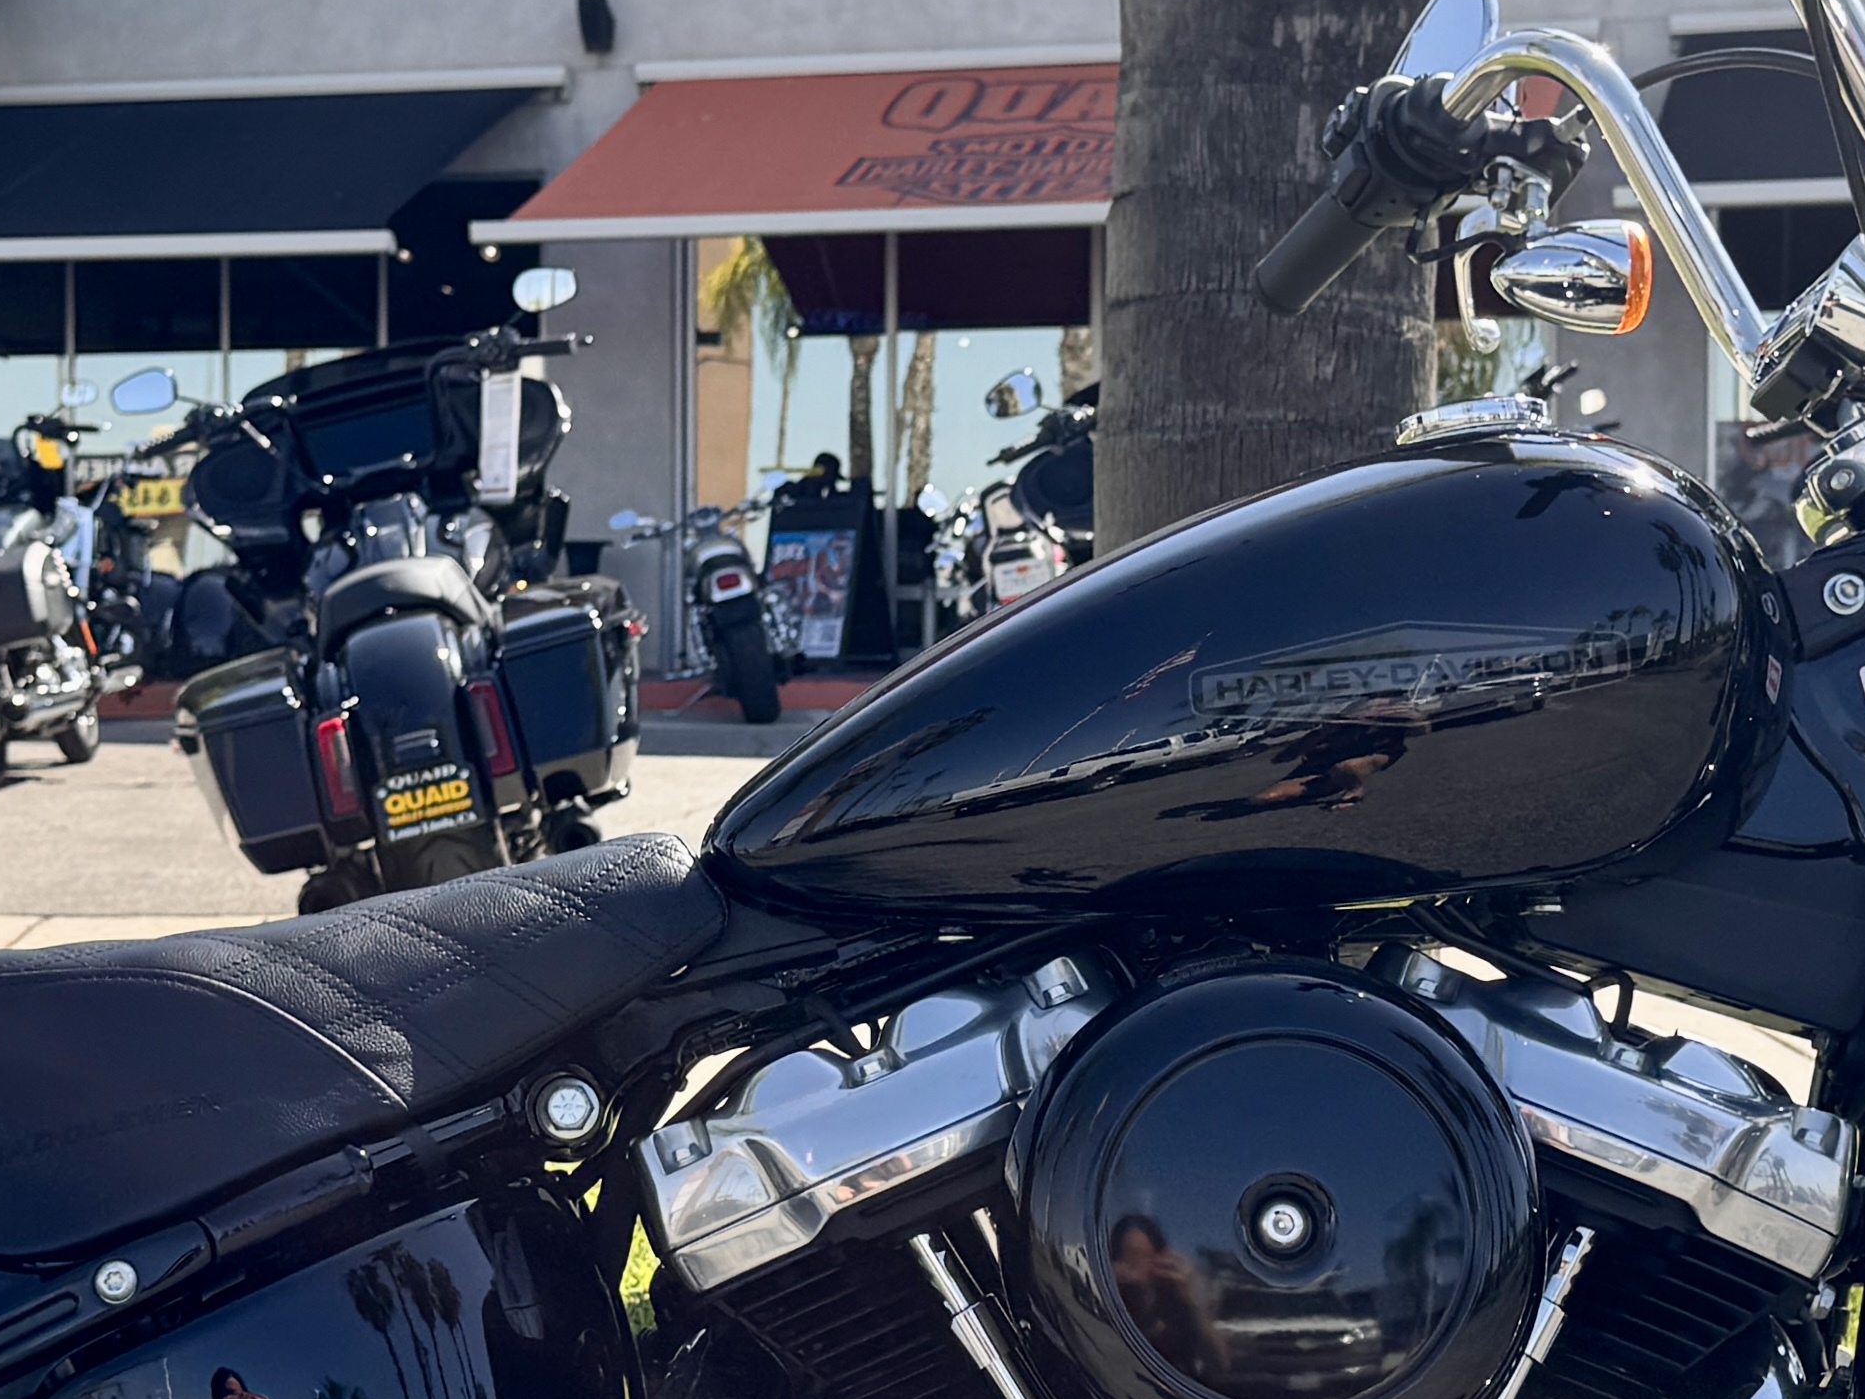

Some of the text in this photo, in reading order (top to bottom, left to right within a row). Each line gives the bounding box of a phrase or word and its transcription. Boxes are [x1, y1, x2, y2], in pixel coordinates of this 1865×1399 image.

[882, 77, 1118, 133] QUA
[1214, 645, 1604, 701] HARLEY-DAVIDSON
[384, 780, 470, 815] QUAID
